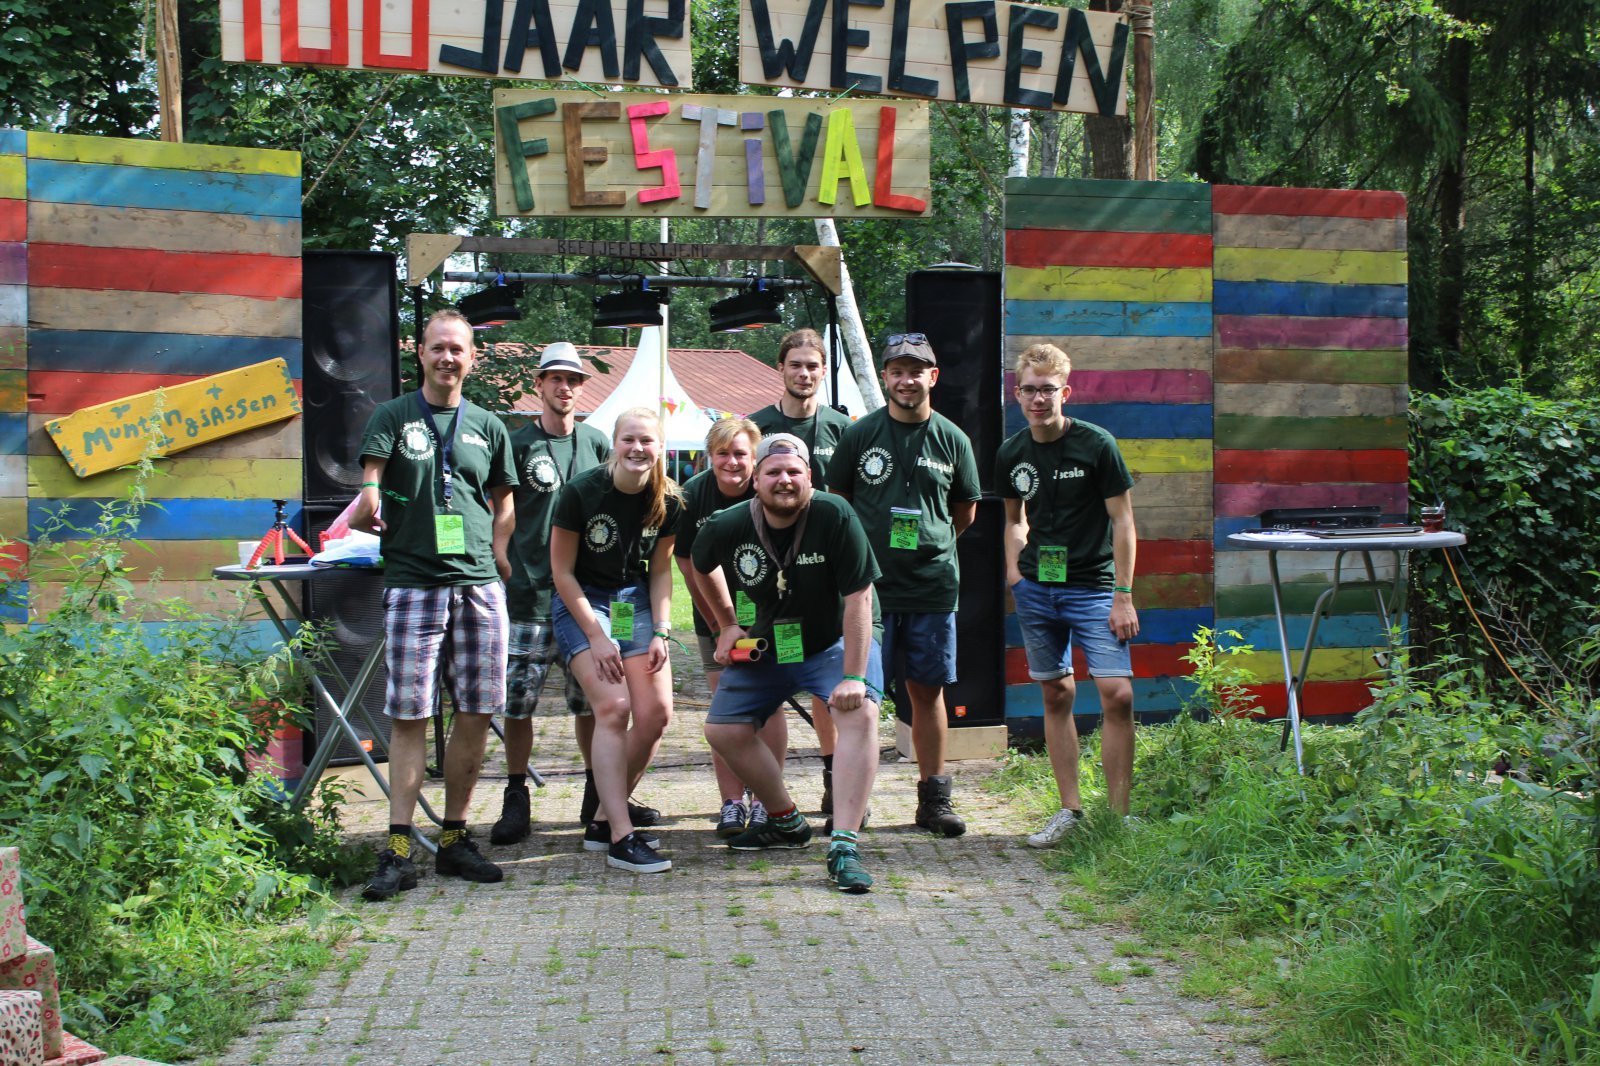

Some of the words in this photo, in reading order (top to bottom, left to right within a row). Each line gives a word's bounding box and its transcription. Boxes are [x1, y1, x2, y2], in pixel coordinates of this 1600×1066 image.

[439, 0, 686, 86] JAAR
[751, 0, 1130, 117] WELPEN
[795, 552, 826, 566] Akela
